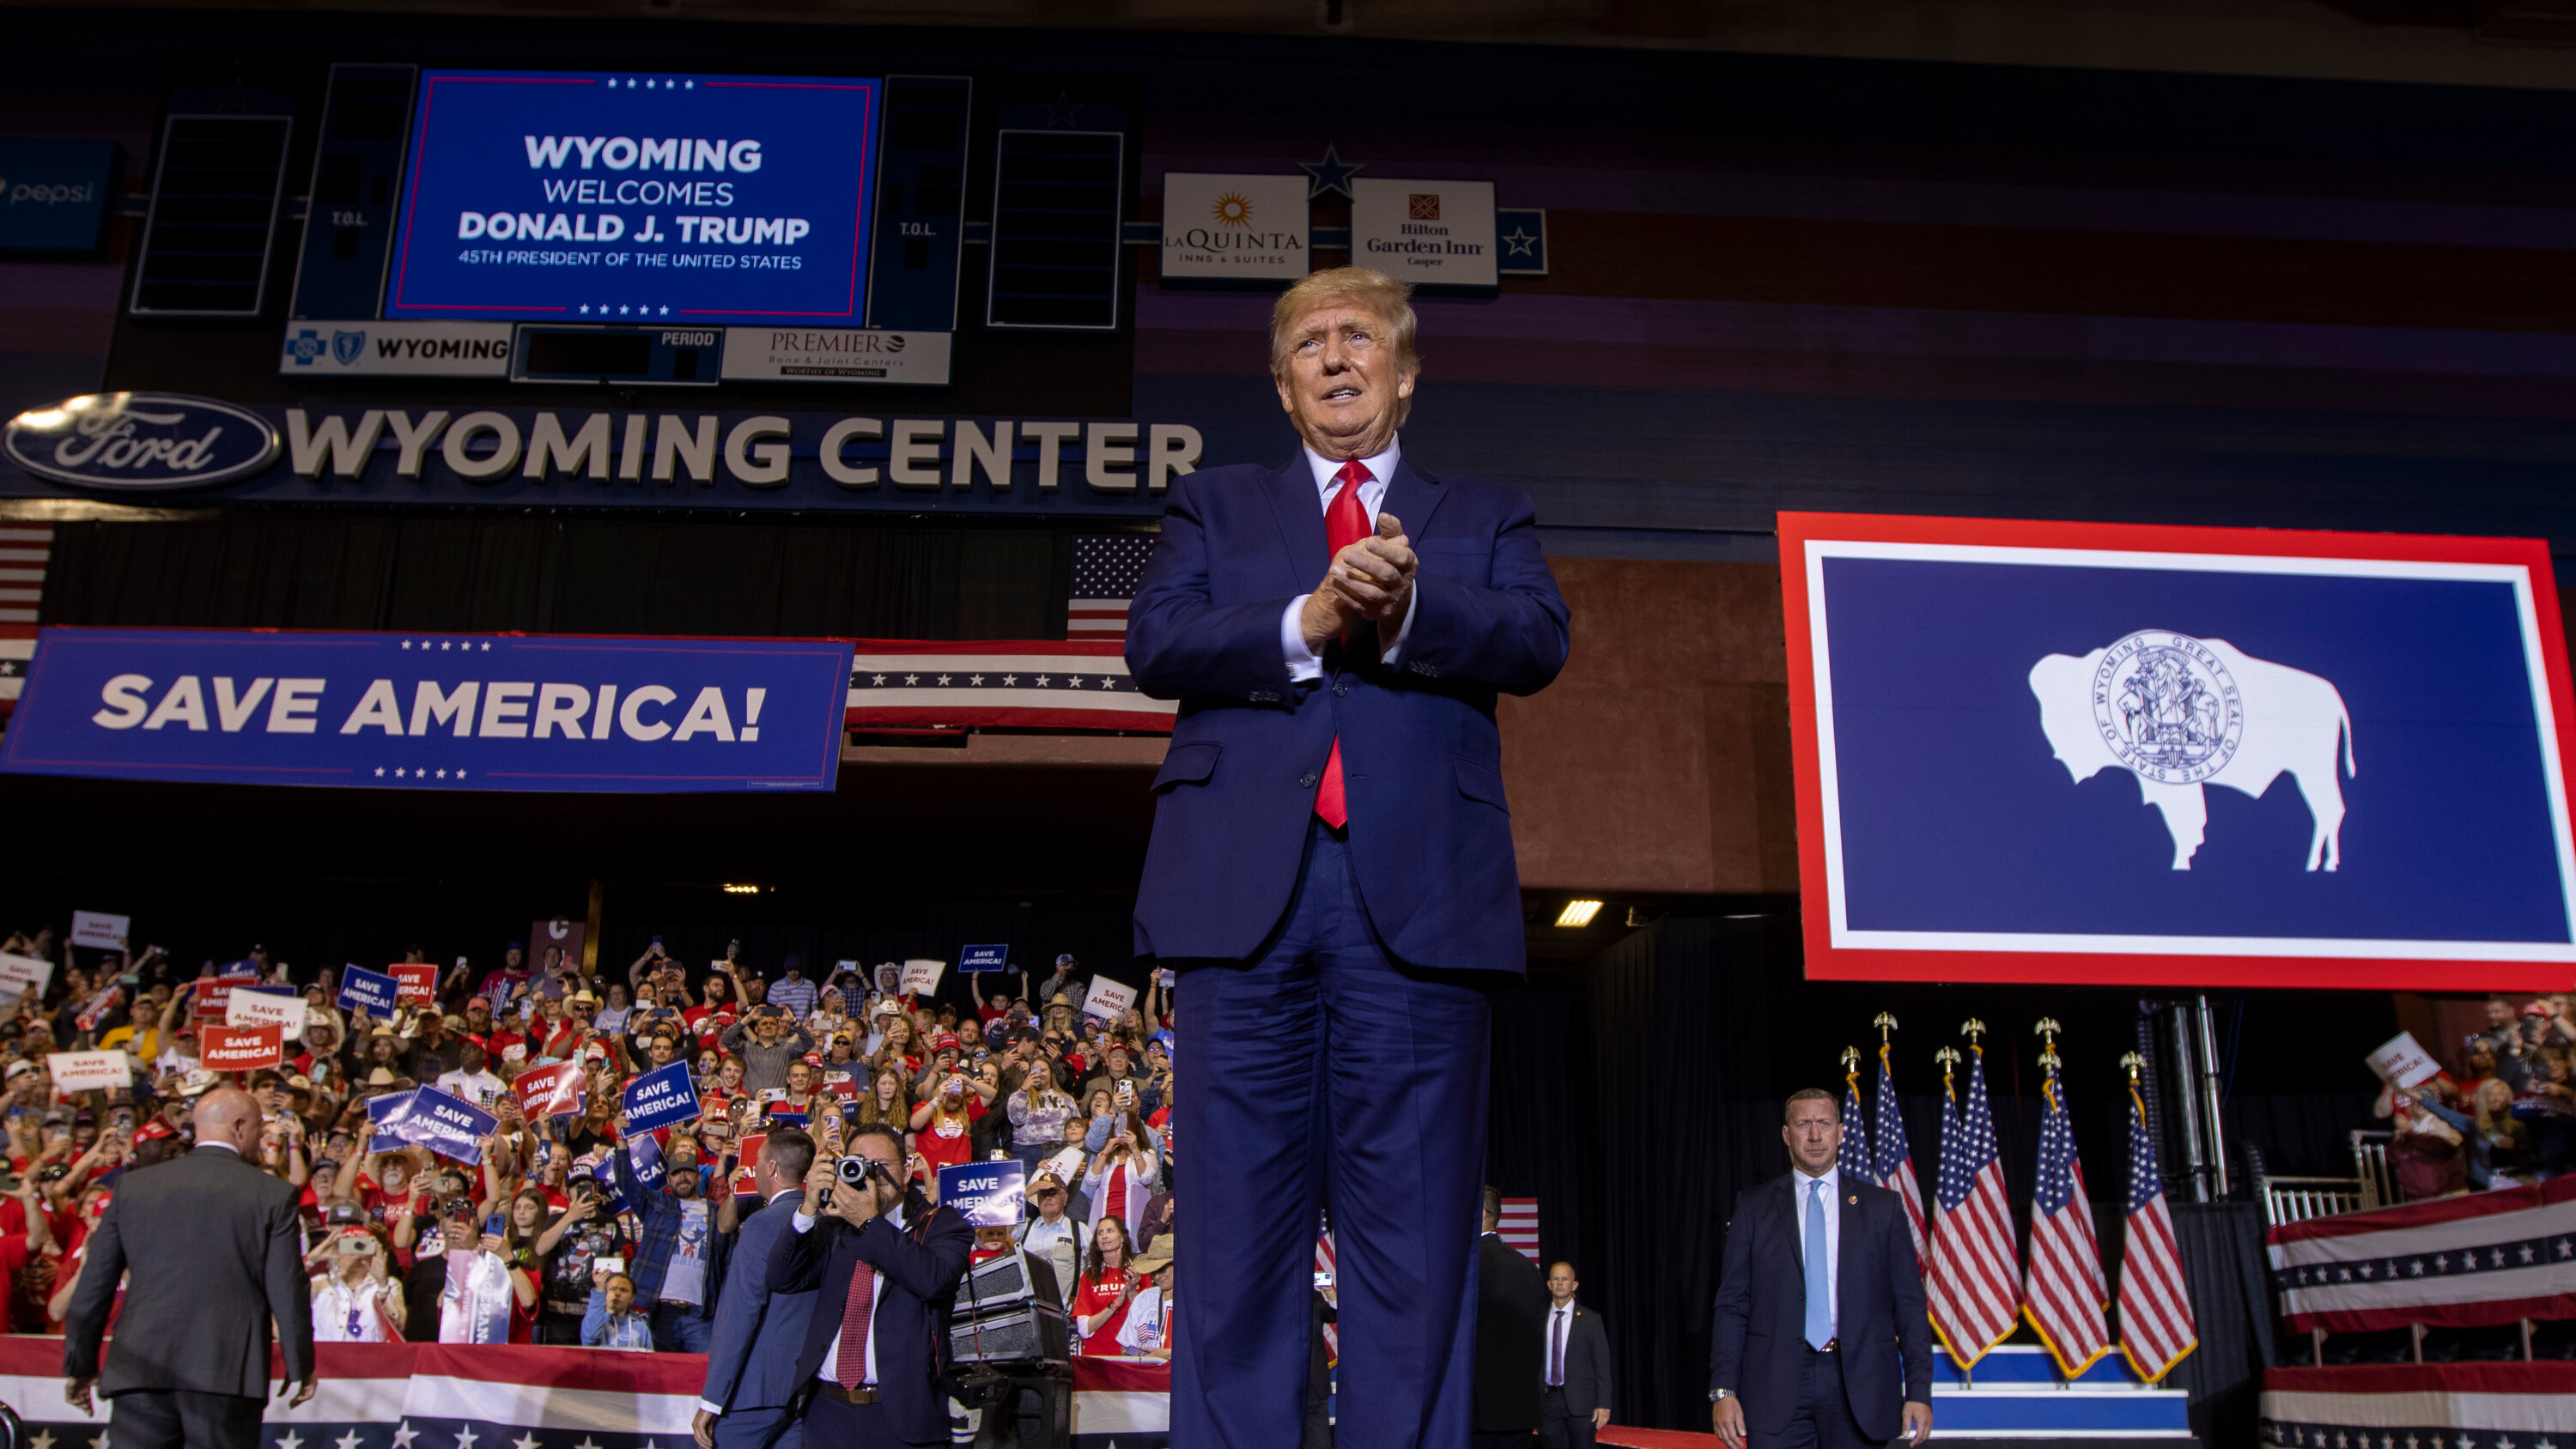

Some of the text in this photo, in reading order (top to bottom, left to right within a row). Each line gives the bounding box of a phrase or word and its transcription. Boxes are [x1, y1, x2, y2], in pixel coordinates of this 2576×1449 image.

[525, 136, 762, 173] WYOMING
[9, 181, 94, 207] pepsi
[544, 179, 734, 207] WELCOMES
[332, 212, 368, 226] T.O.L.
[459, 211, 810, 245] DONALD J. TRUMP
[900, 222, 936, 236] T.O.L.
[1400, 223, 1449, 236] Hilton
[1367, 238, 1483, 256] Garden Inn
[459, 250, 802, 270] 45TH PRESIDENT OF THE UNITED STATES
[1179, 254, 1212, 263] INNS
[1407, 258, 1443, 267] Casper
[377, 337, 508, 359] WYOMING
[661, 331, 714, 347] PERIOD
[771, 331, 884, 353] PREMIER
[769, 355, 799, 364] Bone
[817, 356, 849, 366] Joint
[854, 357, 904, 367] Centers
[54, 411, 223, 470] Ford
[286, 409, 1203, 492] WYOMING CENTER
[91, 674, 766, 742] SAVE AMERICA!
[2096, 636, 2240, 782] GREAT SEAL OF THE STATE OF WYOMING
[548, 919, 569, 940] C
[355, 977, 381, 994] SAVE
[343, 988, 392, 1009] AMERICA!
[1103, 989, 1125, 1003] SAVE
[250, 1003, 285, 1016] SAVE
[1091, 997, 1128, 1015] AMERICA!
[224, 1035, 263, 1048] SAVE
[207, 1046, 277, 1060] AMERICA!
[59, 1067, 125, 1078] AMERICA!
[526, 1076, 556, 1094] SAVE
[636, 1080, 671, 1101] SAVE
[522, 1088, 572, 1113] AMERICA!
[624, 1091, 691, 1119] AMERICA!
[434, 1104, 474, 1128] SAVE
[957, 1177, 999, 1192] SAVE
